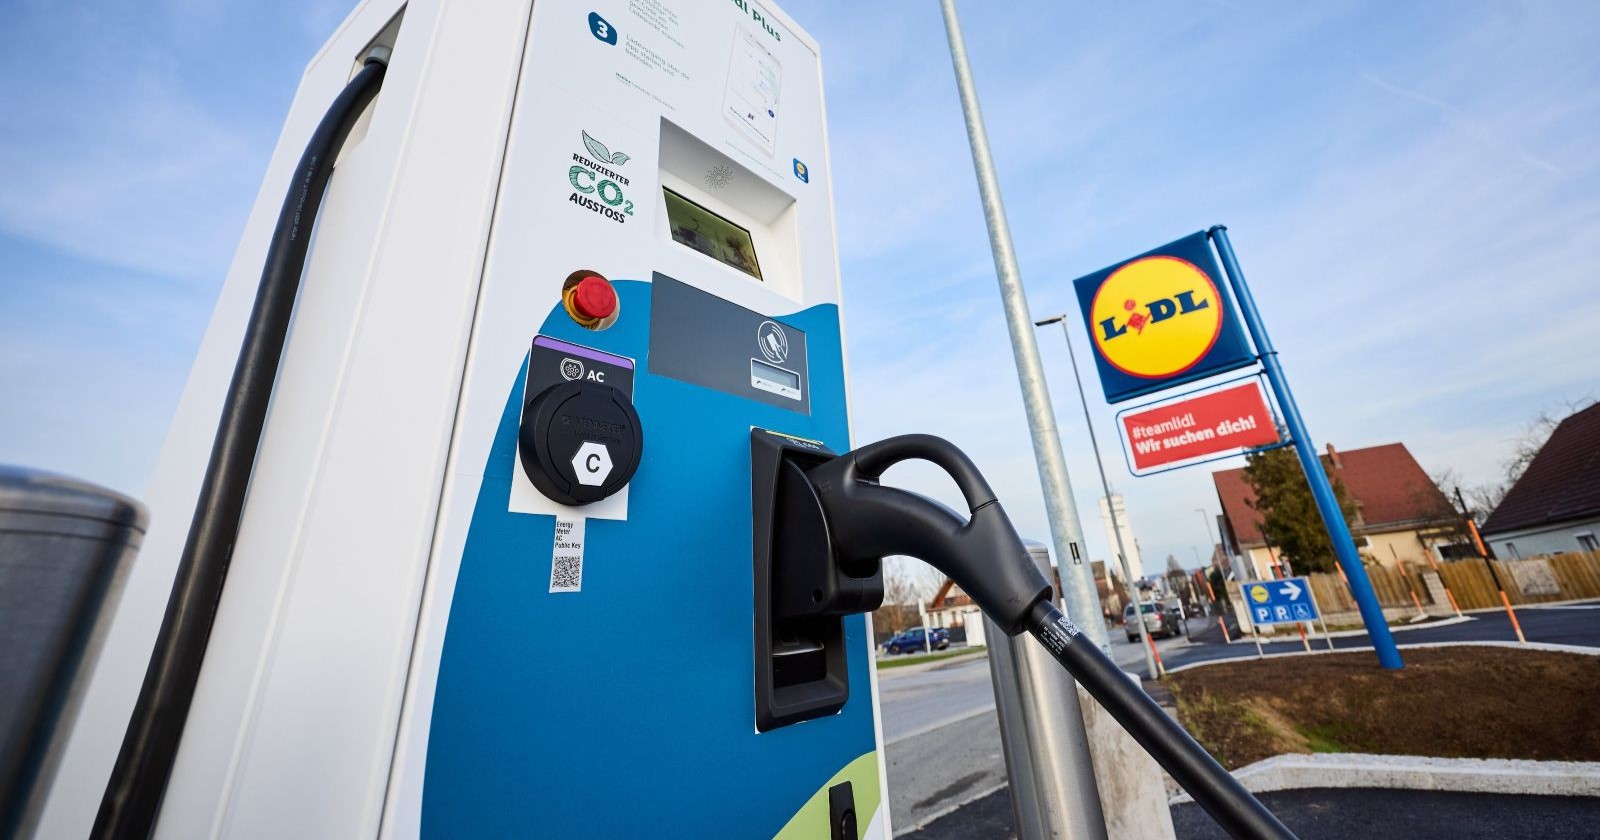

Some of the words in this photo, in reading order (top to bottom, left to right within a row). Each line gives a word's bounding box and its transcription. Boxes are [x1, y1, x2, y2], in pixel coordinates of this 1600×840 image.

[597, 20, 608, 38] 3
[752, 9, 781, 42] Plus
[572, 153, 630, 186] REDUZIERTER
[569, 192, 626, 224] AUSSTOSS
[1100, 289, 1210, 342] LIDL
[586, 369, 605, 383] AC
[1132, 413, 1196, 439] #teamlidl
[1135, 438, 1162, 455] Wir
[1163, 428, 1215, 450] suchen
[1216, 415, 1257, 437] dich!
[585, 453, 601, 474] C
[556, 520, 574, 529] Energy
[554, 541, 571, 549] Public
[571, 542, 582, 550] Key
[1257, 608, 1269, 621] P
